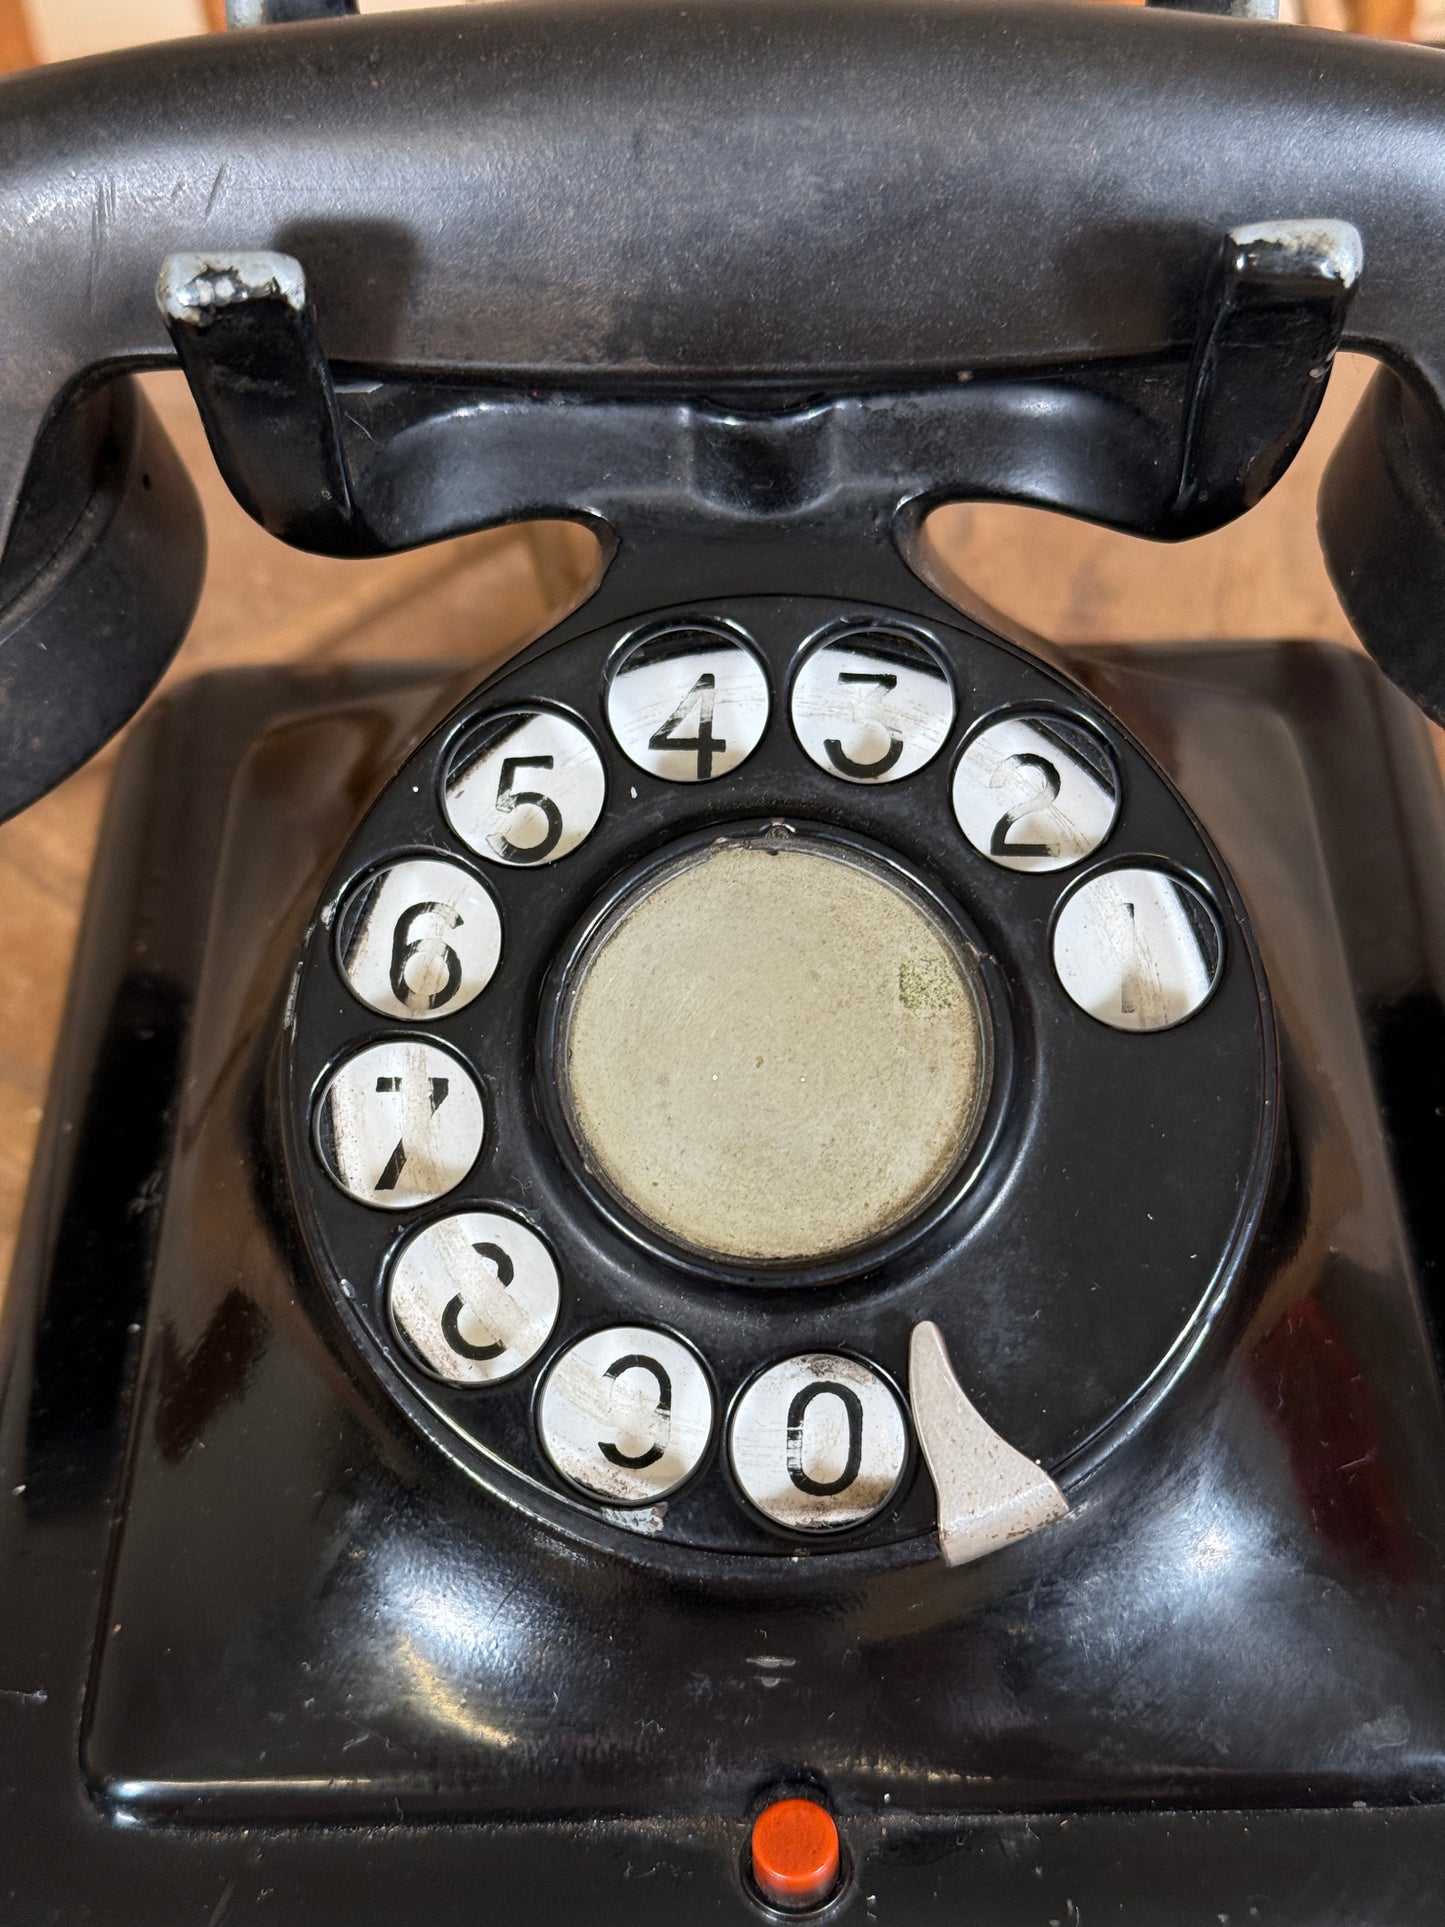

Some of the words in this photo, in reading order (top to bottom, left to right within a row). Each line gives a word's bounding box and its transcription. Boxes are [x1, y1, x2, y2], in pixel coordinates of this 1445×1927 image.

[648, 672, 727, 778] 4
[823, 672, 904, 778] 3
[485, 755, 563, 861] 5
[988, 753, 1062, 858] 2
[391, 900, 465, 1011] 6
[374, 1076, 450, 1191] 7
[786, 1380, 864, 1497] 0
